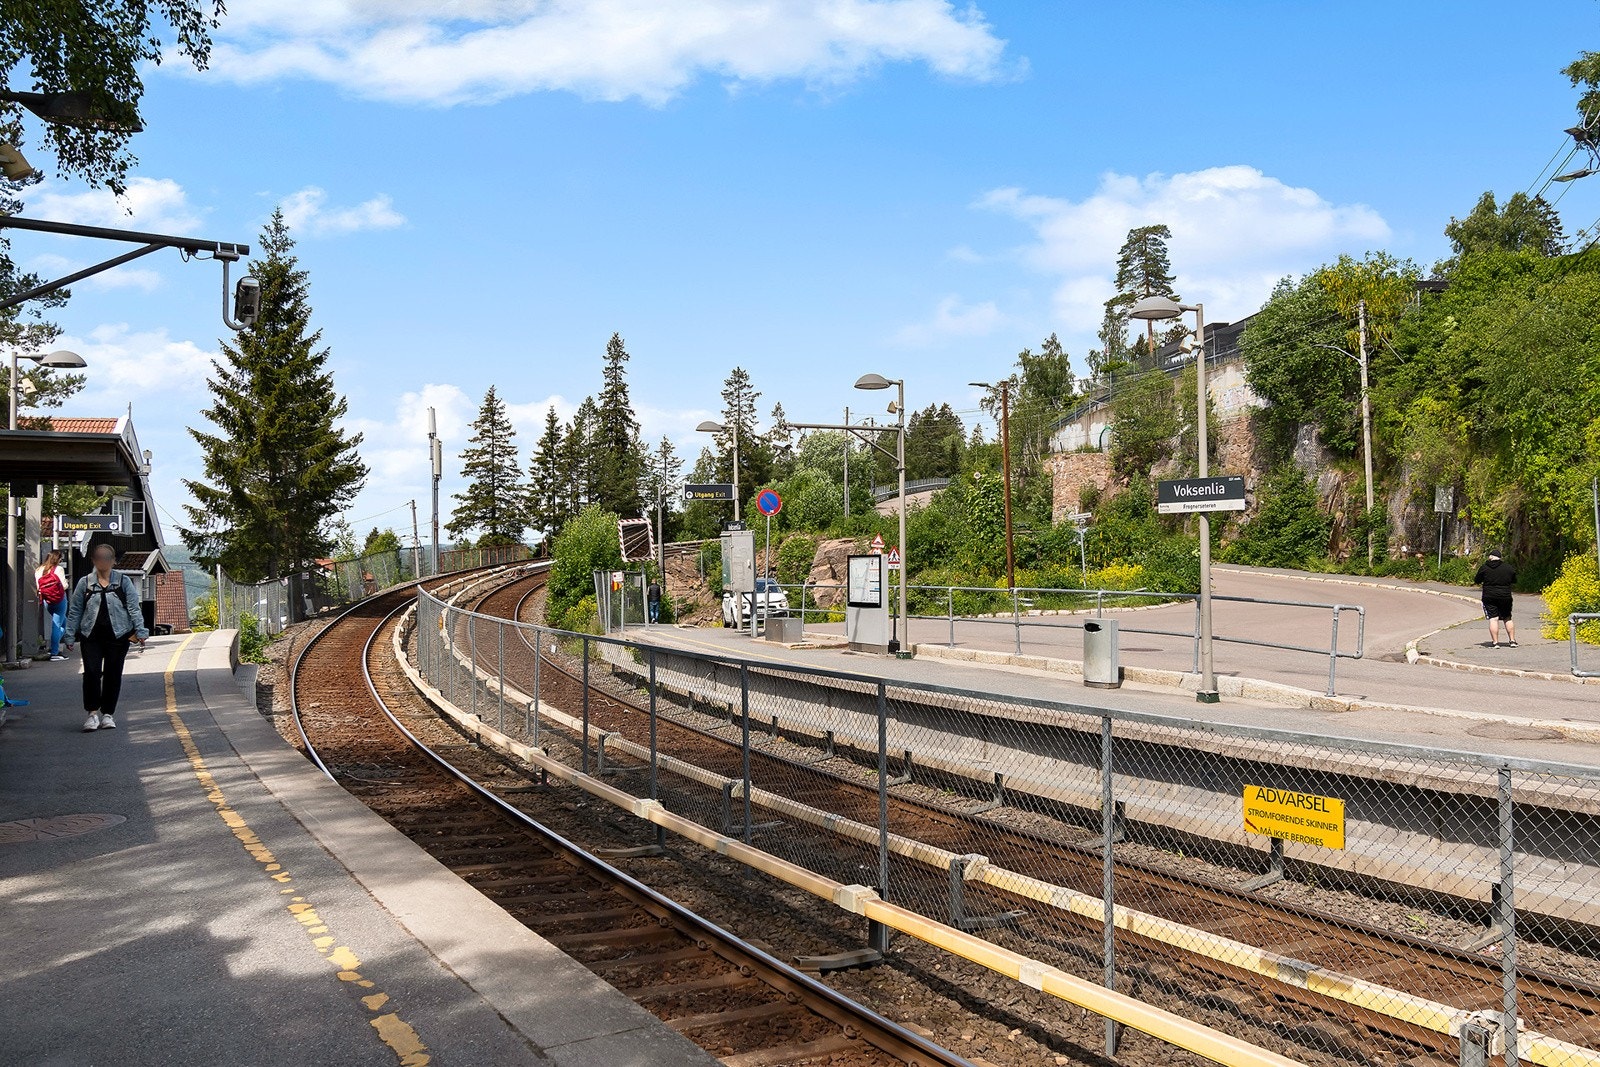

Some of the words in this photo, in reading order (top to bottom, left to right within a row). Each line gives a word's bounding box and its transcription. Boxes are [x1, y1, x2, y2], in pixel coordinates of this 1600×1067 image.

[694, 491, 715, 499] Utgang
[1173, 482, 1225, 497] Voksenlia
[64, 522, 88, 530] Utgang
[1255, 787, 1330, 813] ADVARSEL
[1305, 819, 1339, 832] SKINNER
[1273, 830, 1289, 840] IKKE
